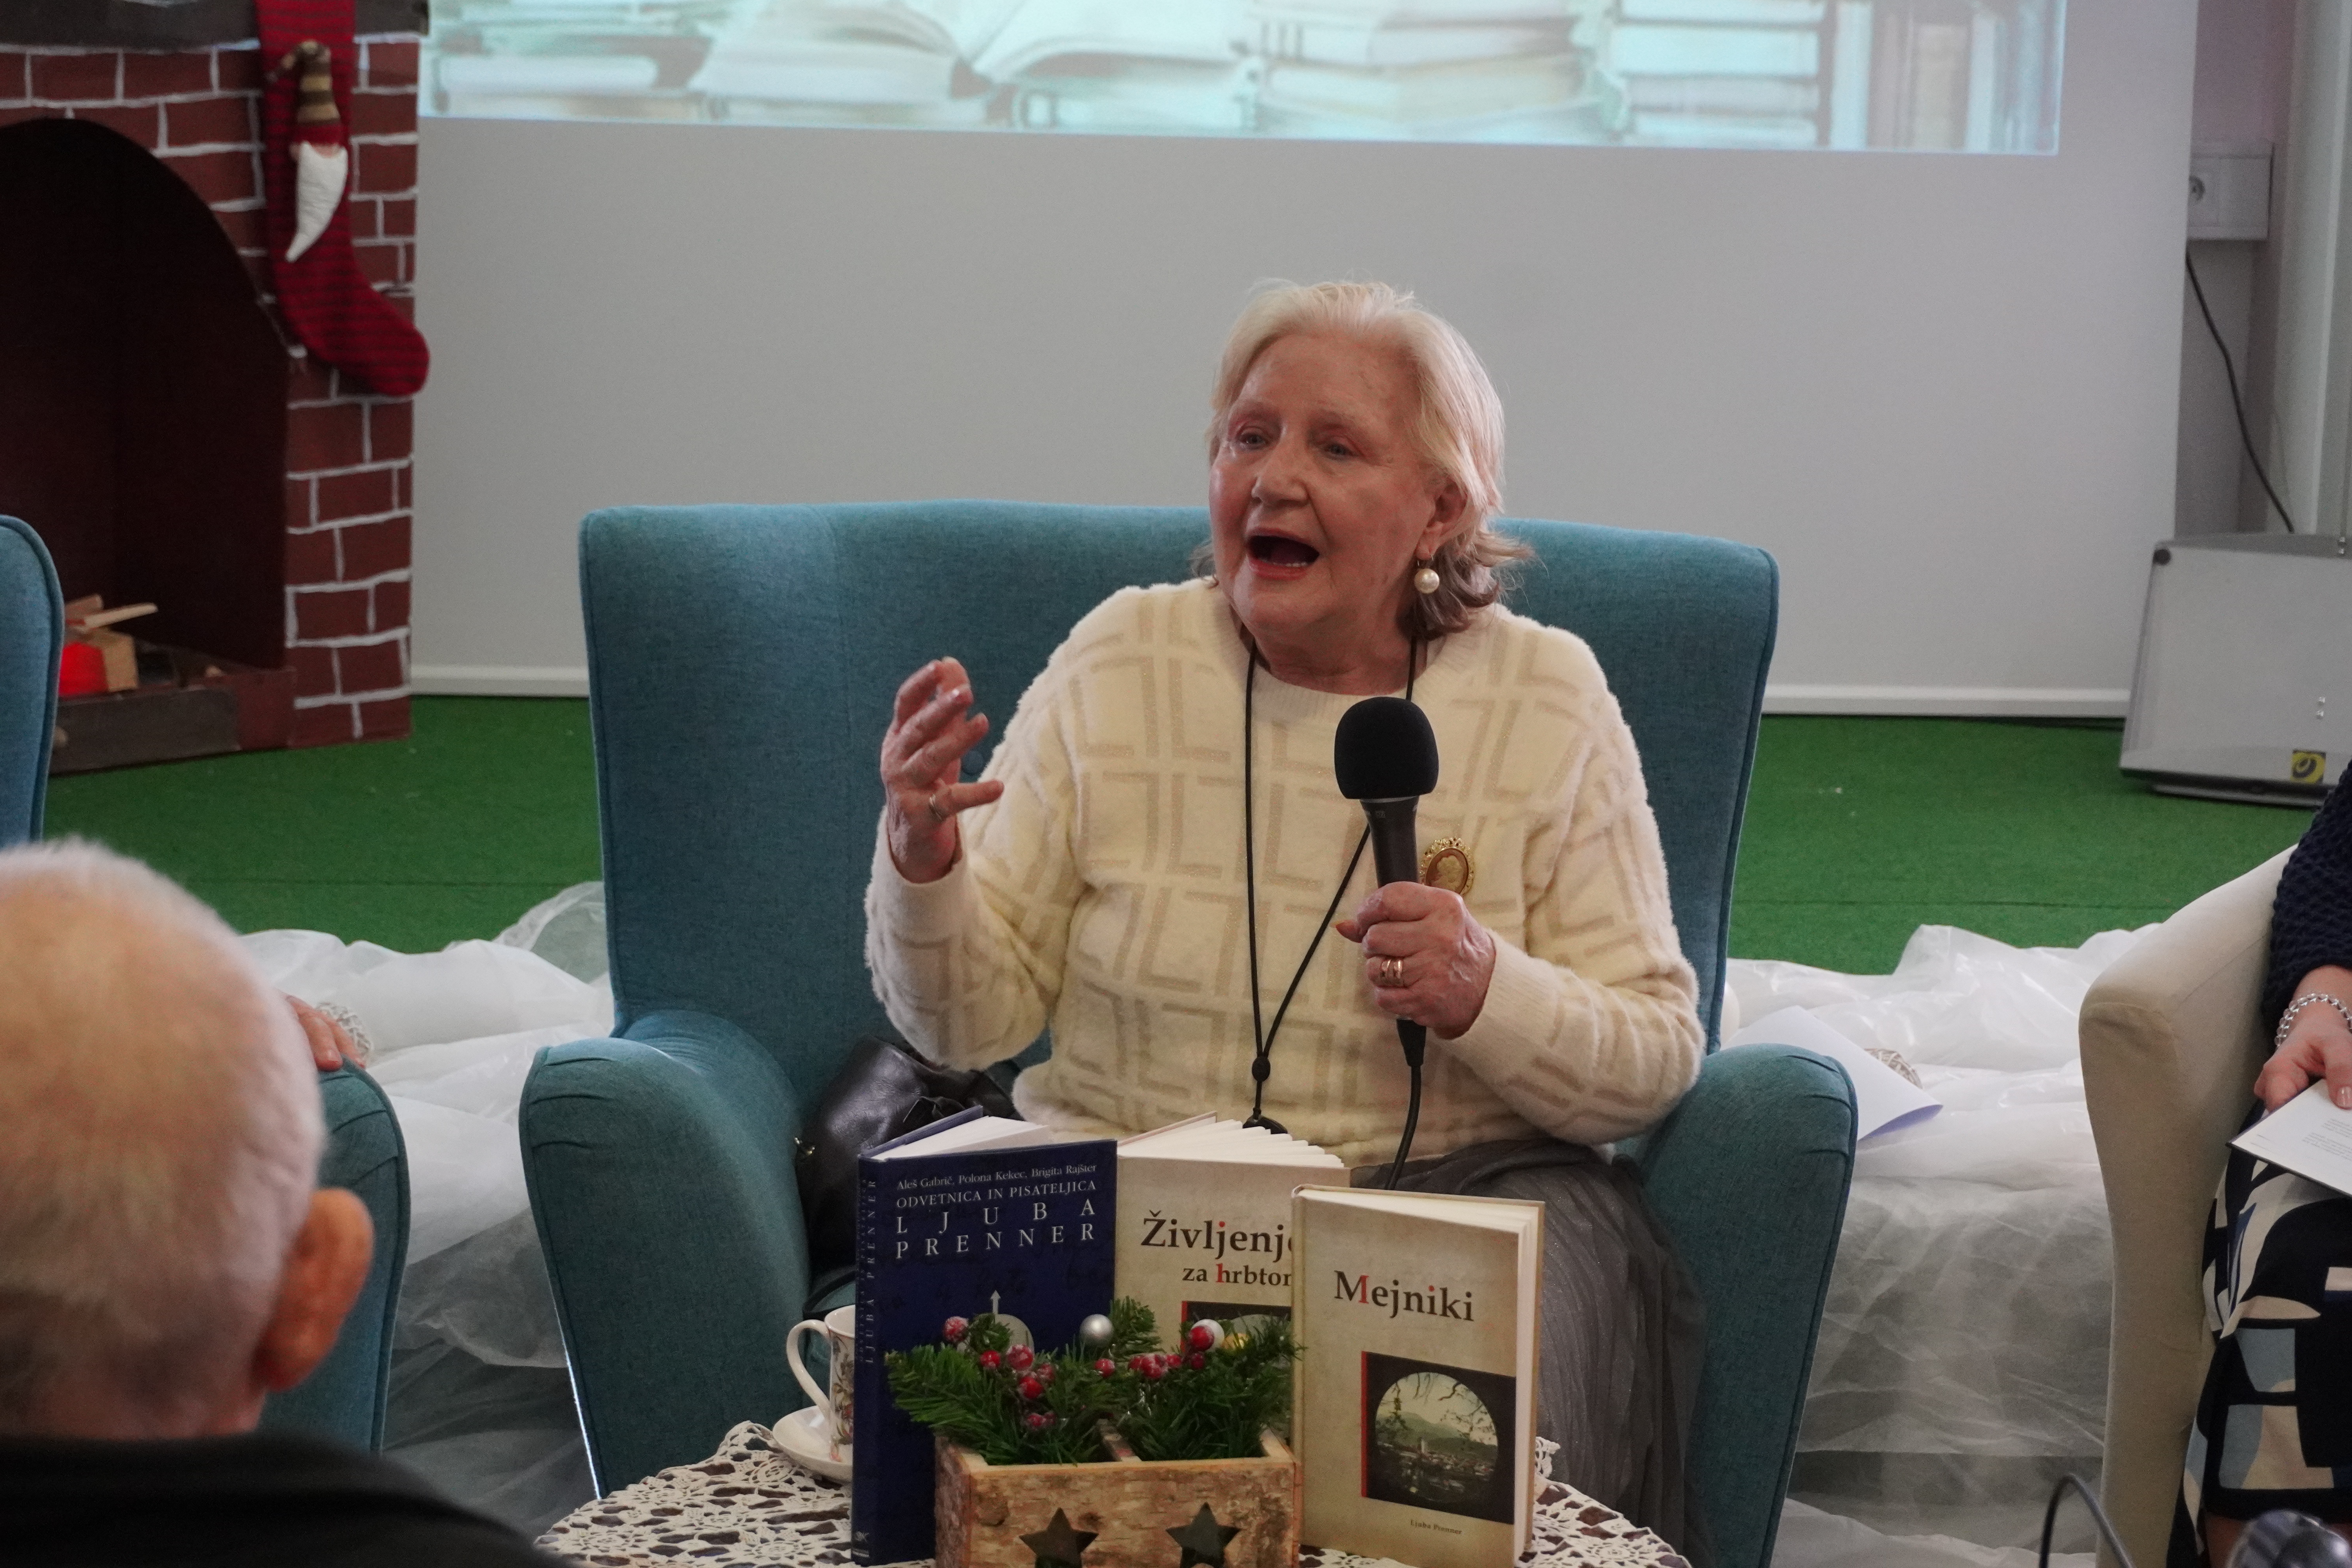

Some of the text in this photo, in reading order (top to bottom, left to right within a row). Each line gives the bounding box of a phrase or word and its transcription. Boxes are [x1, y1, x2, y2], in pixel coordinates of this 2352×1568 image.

[896, 1180, 1096, 1209] ODVETNICA IN PISATELJICA
[897, 1179, 917, 1190] Aleš
[959, 1173, 992, 1184] Polona
[1032, 1167, 1063, 1179] Brigita
[1065, 1164, 1097, 1175] Rajšter
[896, 1198, 1096, 1234] LJUBA
[895, 1223, 1094, 1259] PRENNER
[1140, 1209, 1292, 1263] Življenj
[865, 1181, 876, 1364] LJUBA PRENNER
[1182, 1267, 1208, 1282] za
[1334, 1270, 1474, 1322] Mejniki
